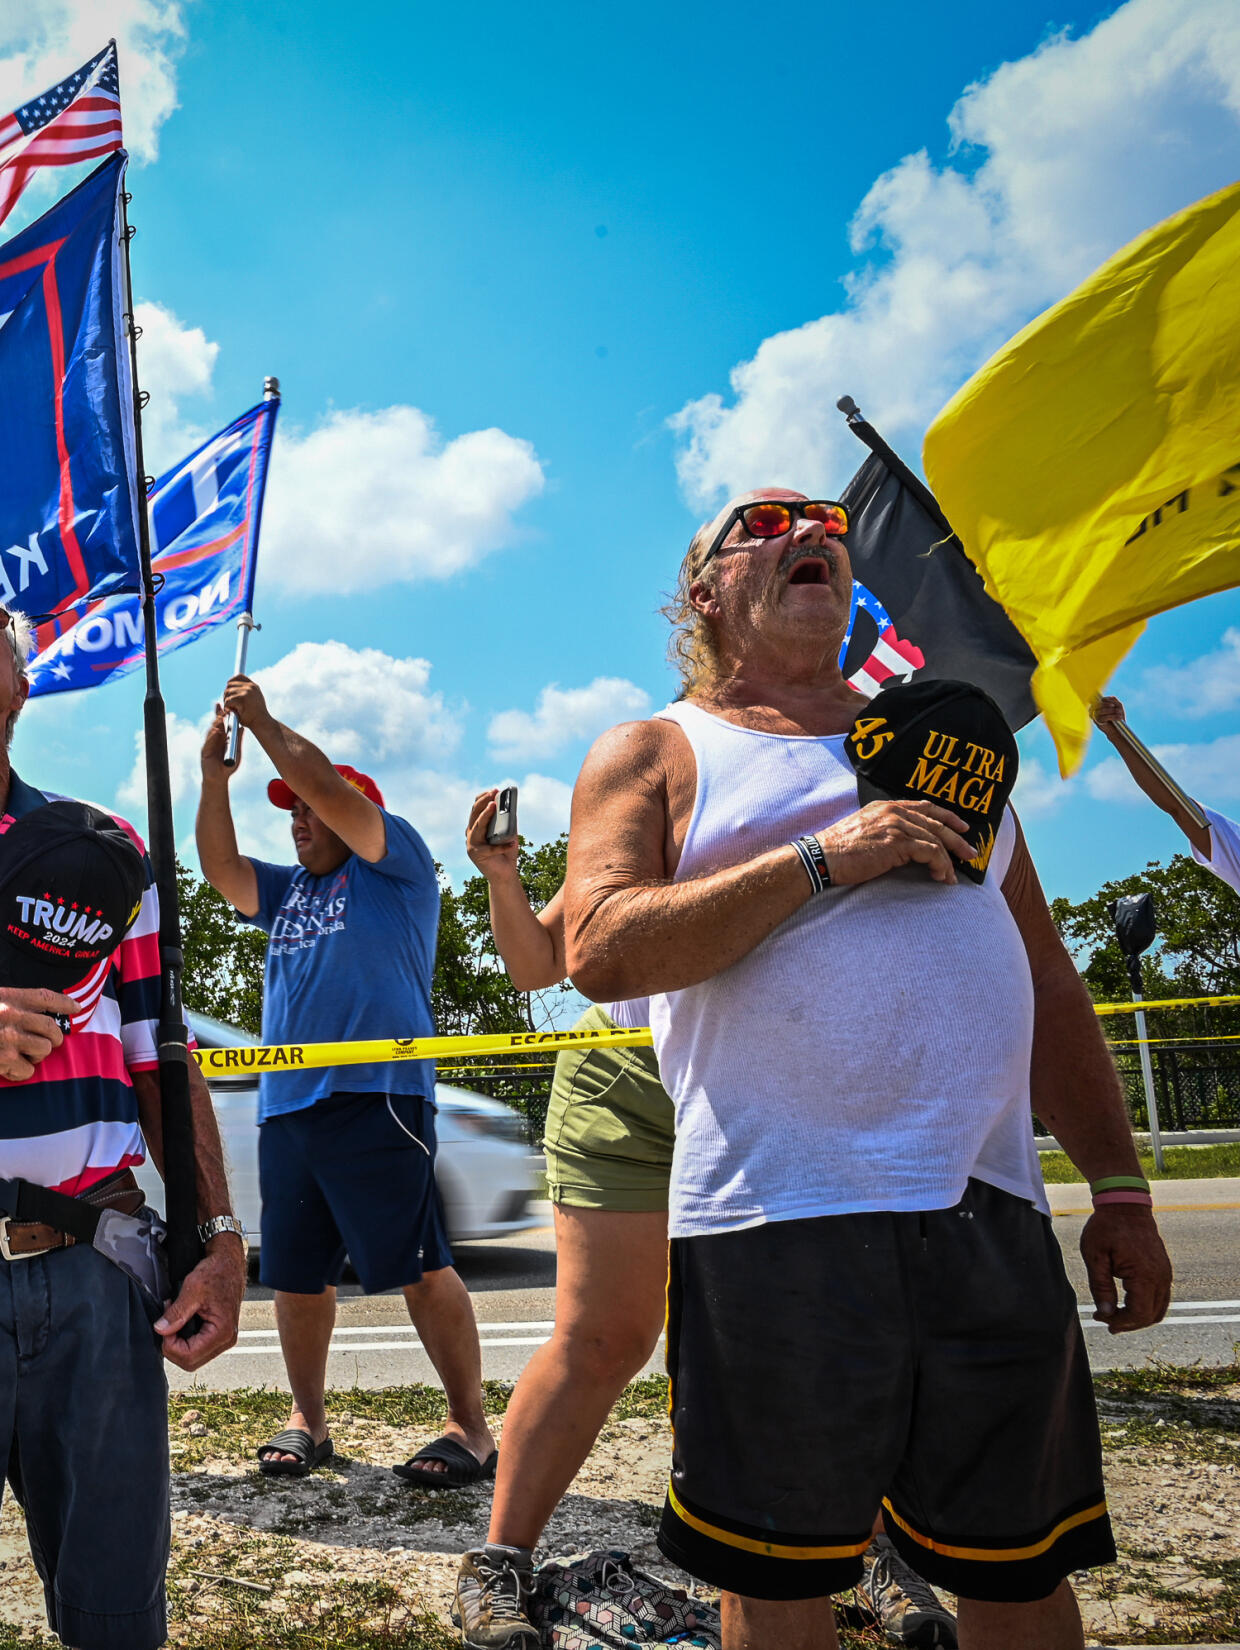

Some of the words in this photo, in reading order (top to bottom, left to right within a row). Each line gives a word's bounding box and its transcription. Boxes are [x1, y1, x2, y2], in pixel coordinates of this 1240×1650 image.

[850, 717, 895, 760] 45
[922, 729, 1006, 783] ULTRA
[905, 757, 996, 815] MAGA
[7, 923, 31, 940] KEEP
[30, 937, 71, 958] AMERICA
[16, 895, 113, 945] TRUMP
[43, 931, 77, 948] 2024
[209, 1046, 305, 1068] CRUZAR
